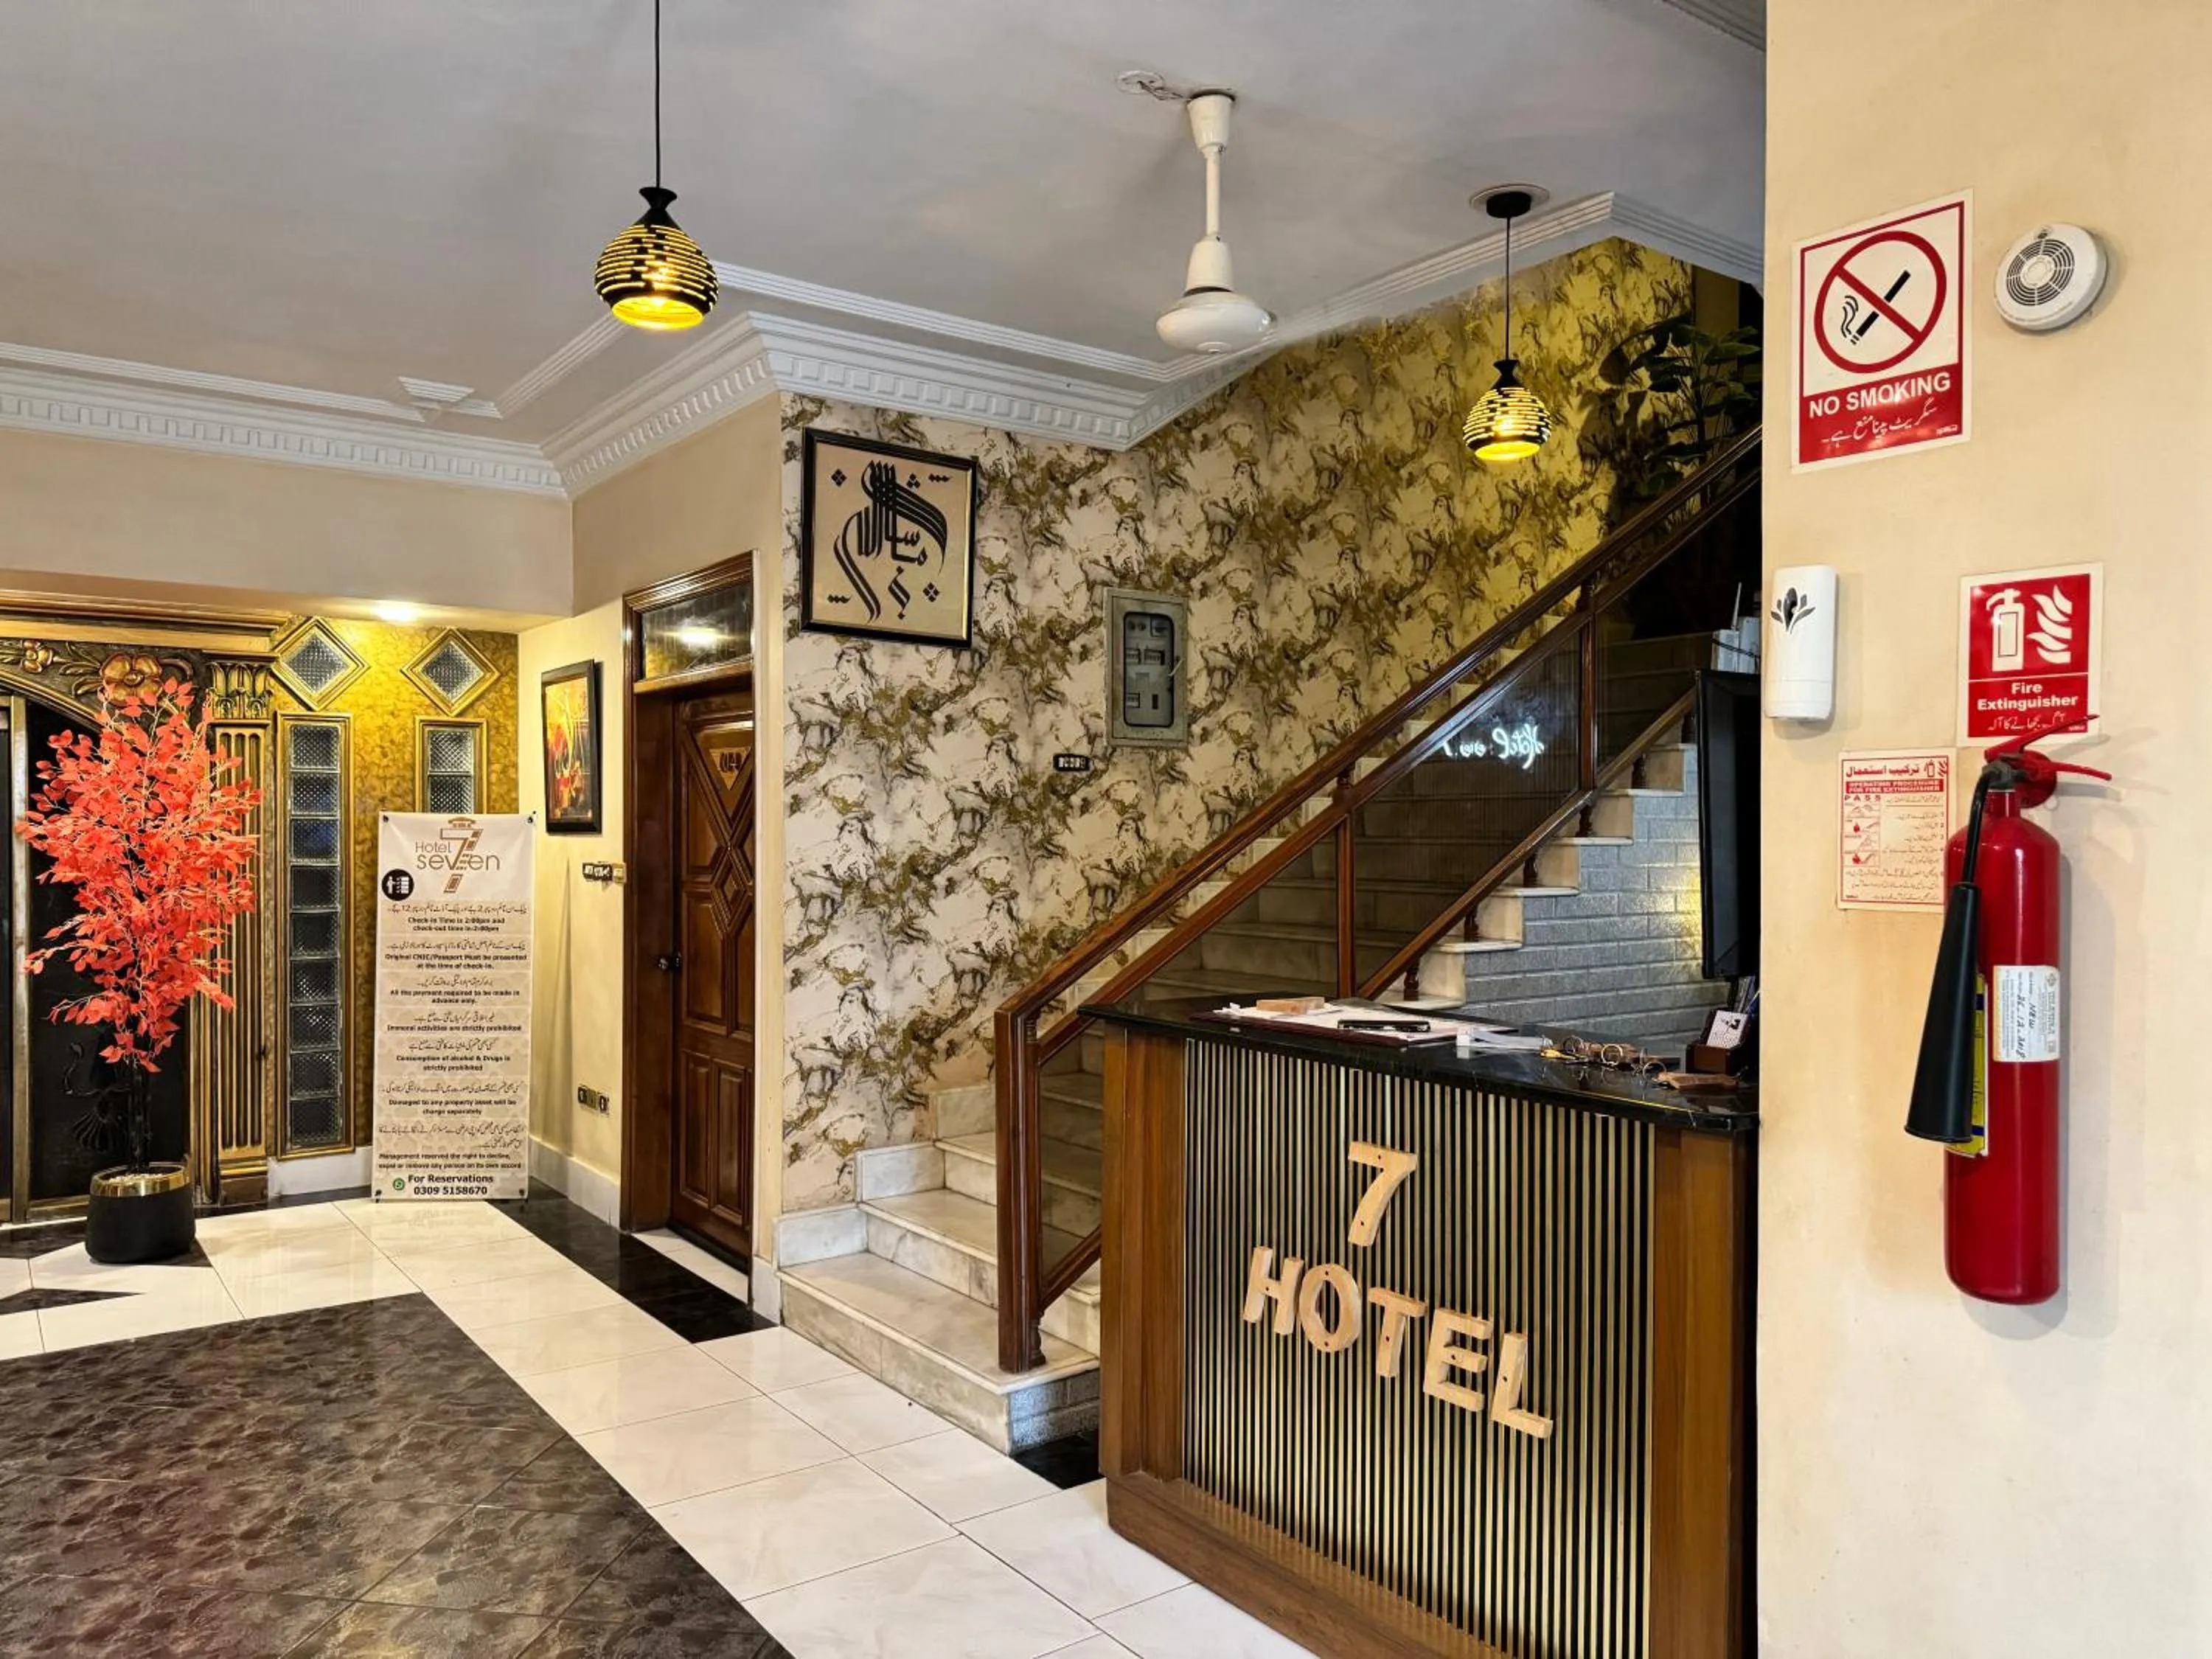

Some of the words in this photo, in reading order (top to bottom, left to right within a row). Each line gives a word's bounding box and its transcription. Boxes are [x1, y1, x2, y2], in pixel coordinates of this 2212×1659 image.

[1809, 396, 1840, 418] NO
[1846, 372, 1951, 411] SMOKING
[2011, 682, 2042, 695] Fire
[1977, 695, 2079, 712] Extinguisher
[415, 841, 451, 853] Hotel
[408, 1175, 425, 1183] For
[428, 1175, 494, 1183] Reservations
[414, 1186, 439, 1195] 0309
[442, 1186, 487, 1195] 5158670
[1348, 1141, 1417, 1246] 7
[1242, 1245, 1554, 1439] HOTEL
